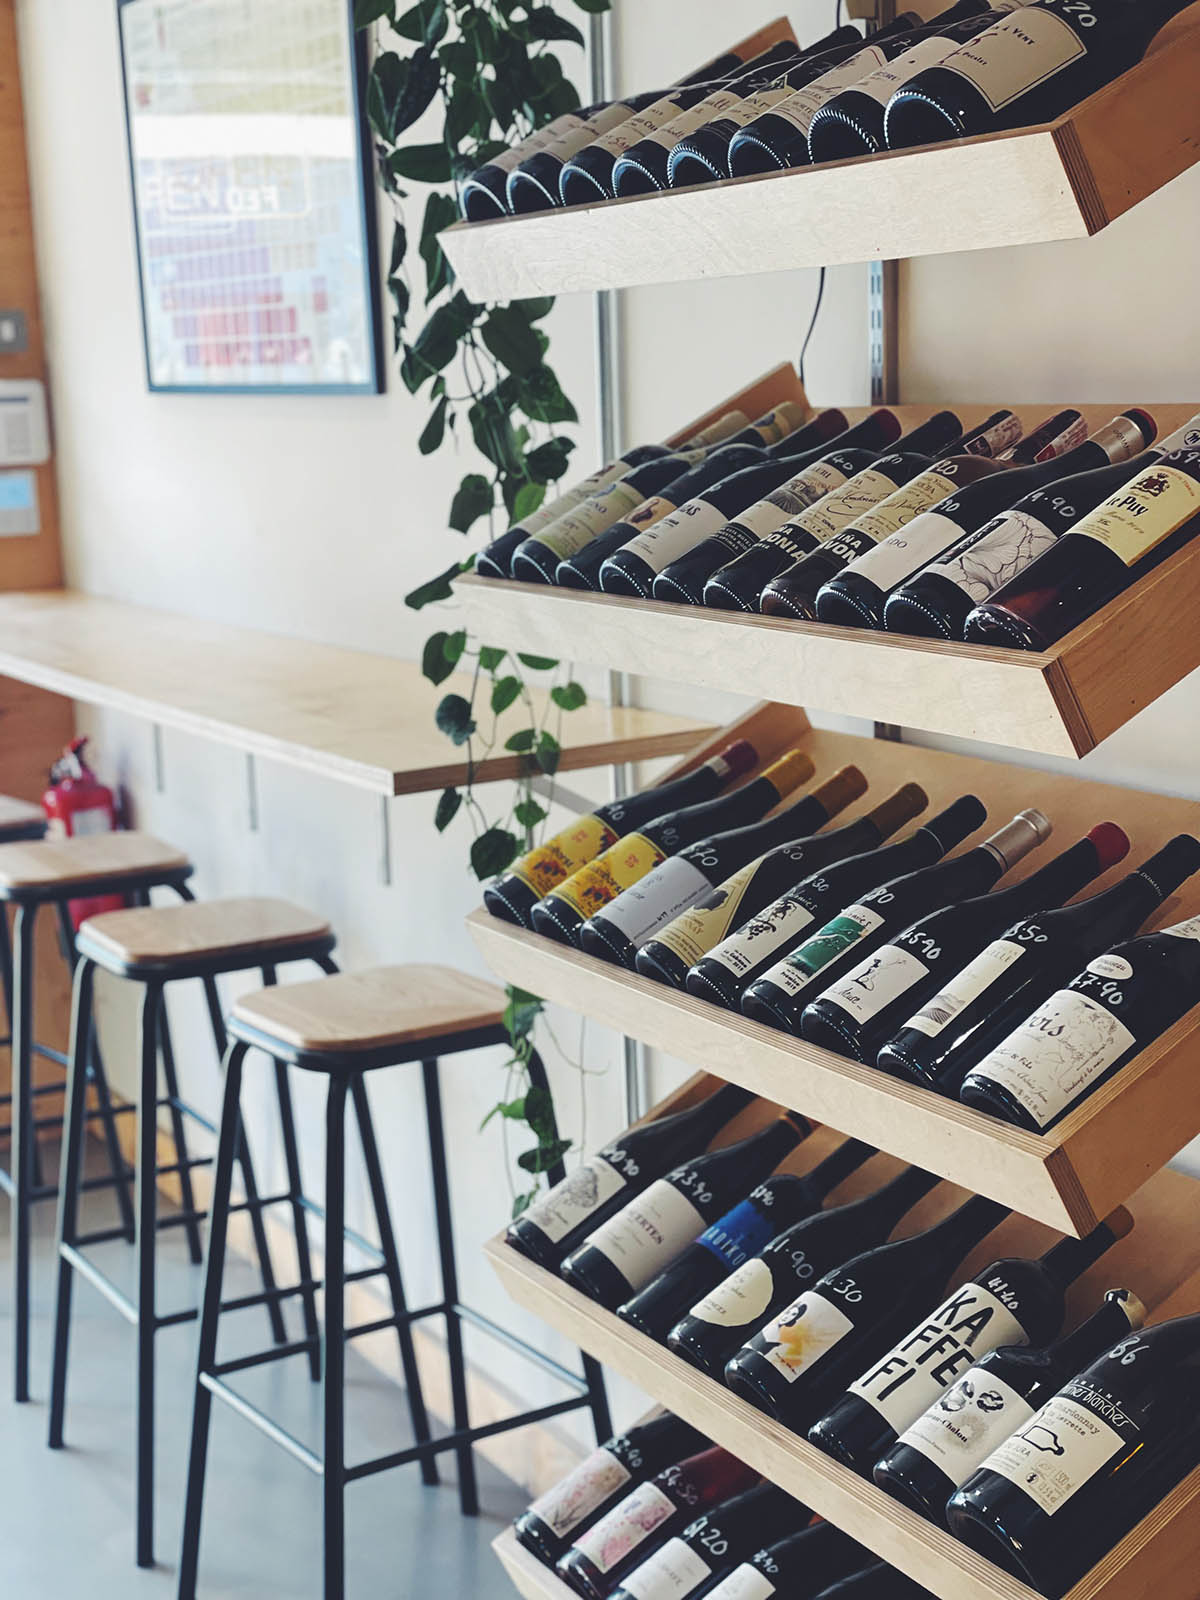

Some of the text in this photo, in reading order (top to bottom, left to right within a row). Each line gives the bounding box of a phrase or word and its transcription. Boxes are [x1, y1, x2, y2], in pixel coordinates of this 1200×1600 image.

[1119, 495, 1149, 517] Puy
[631, 1210, 665, 1246] ERTES
[933, 1289, 995, 1347] KA
[900, 1324, 976, 1388] FFE
[860, 1356, 917, 1402] FI
[1082, 1388, 1129, 1428] blanches
